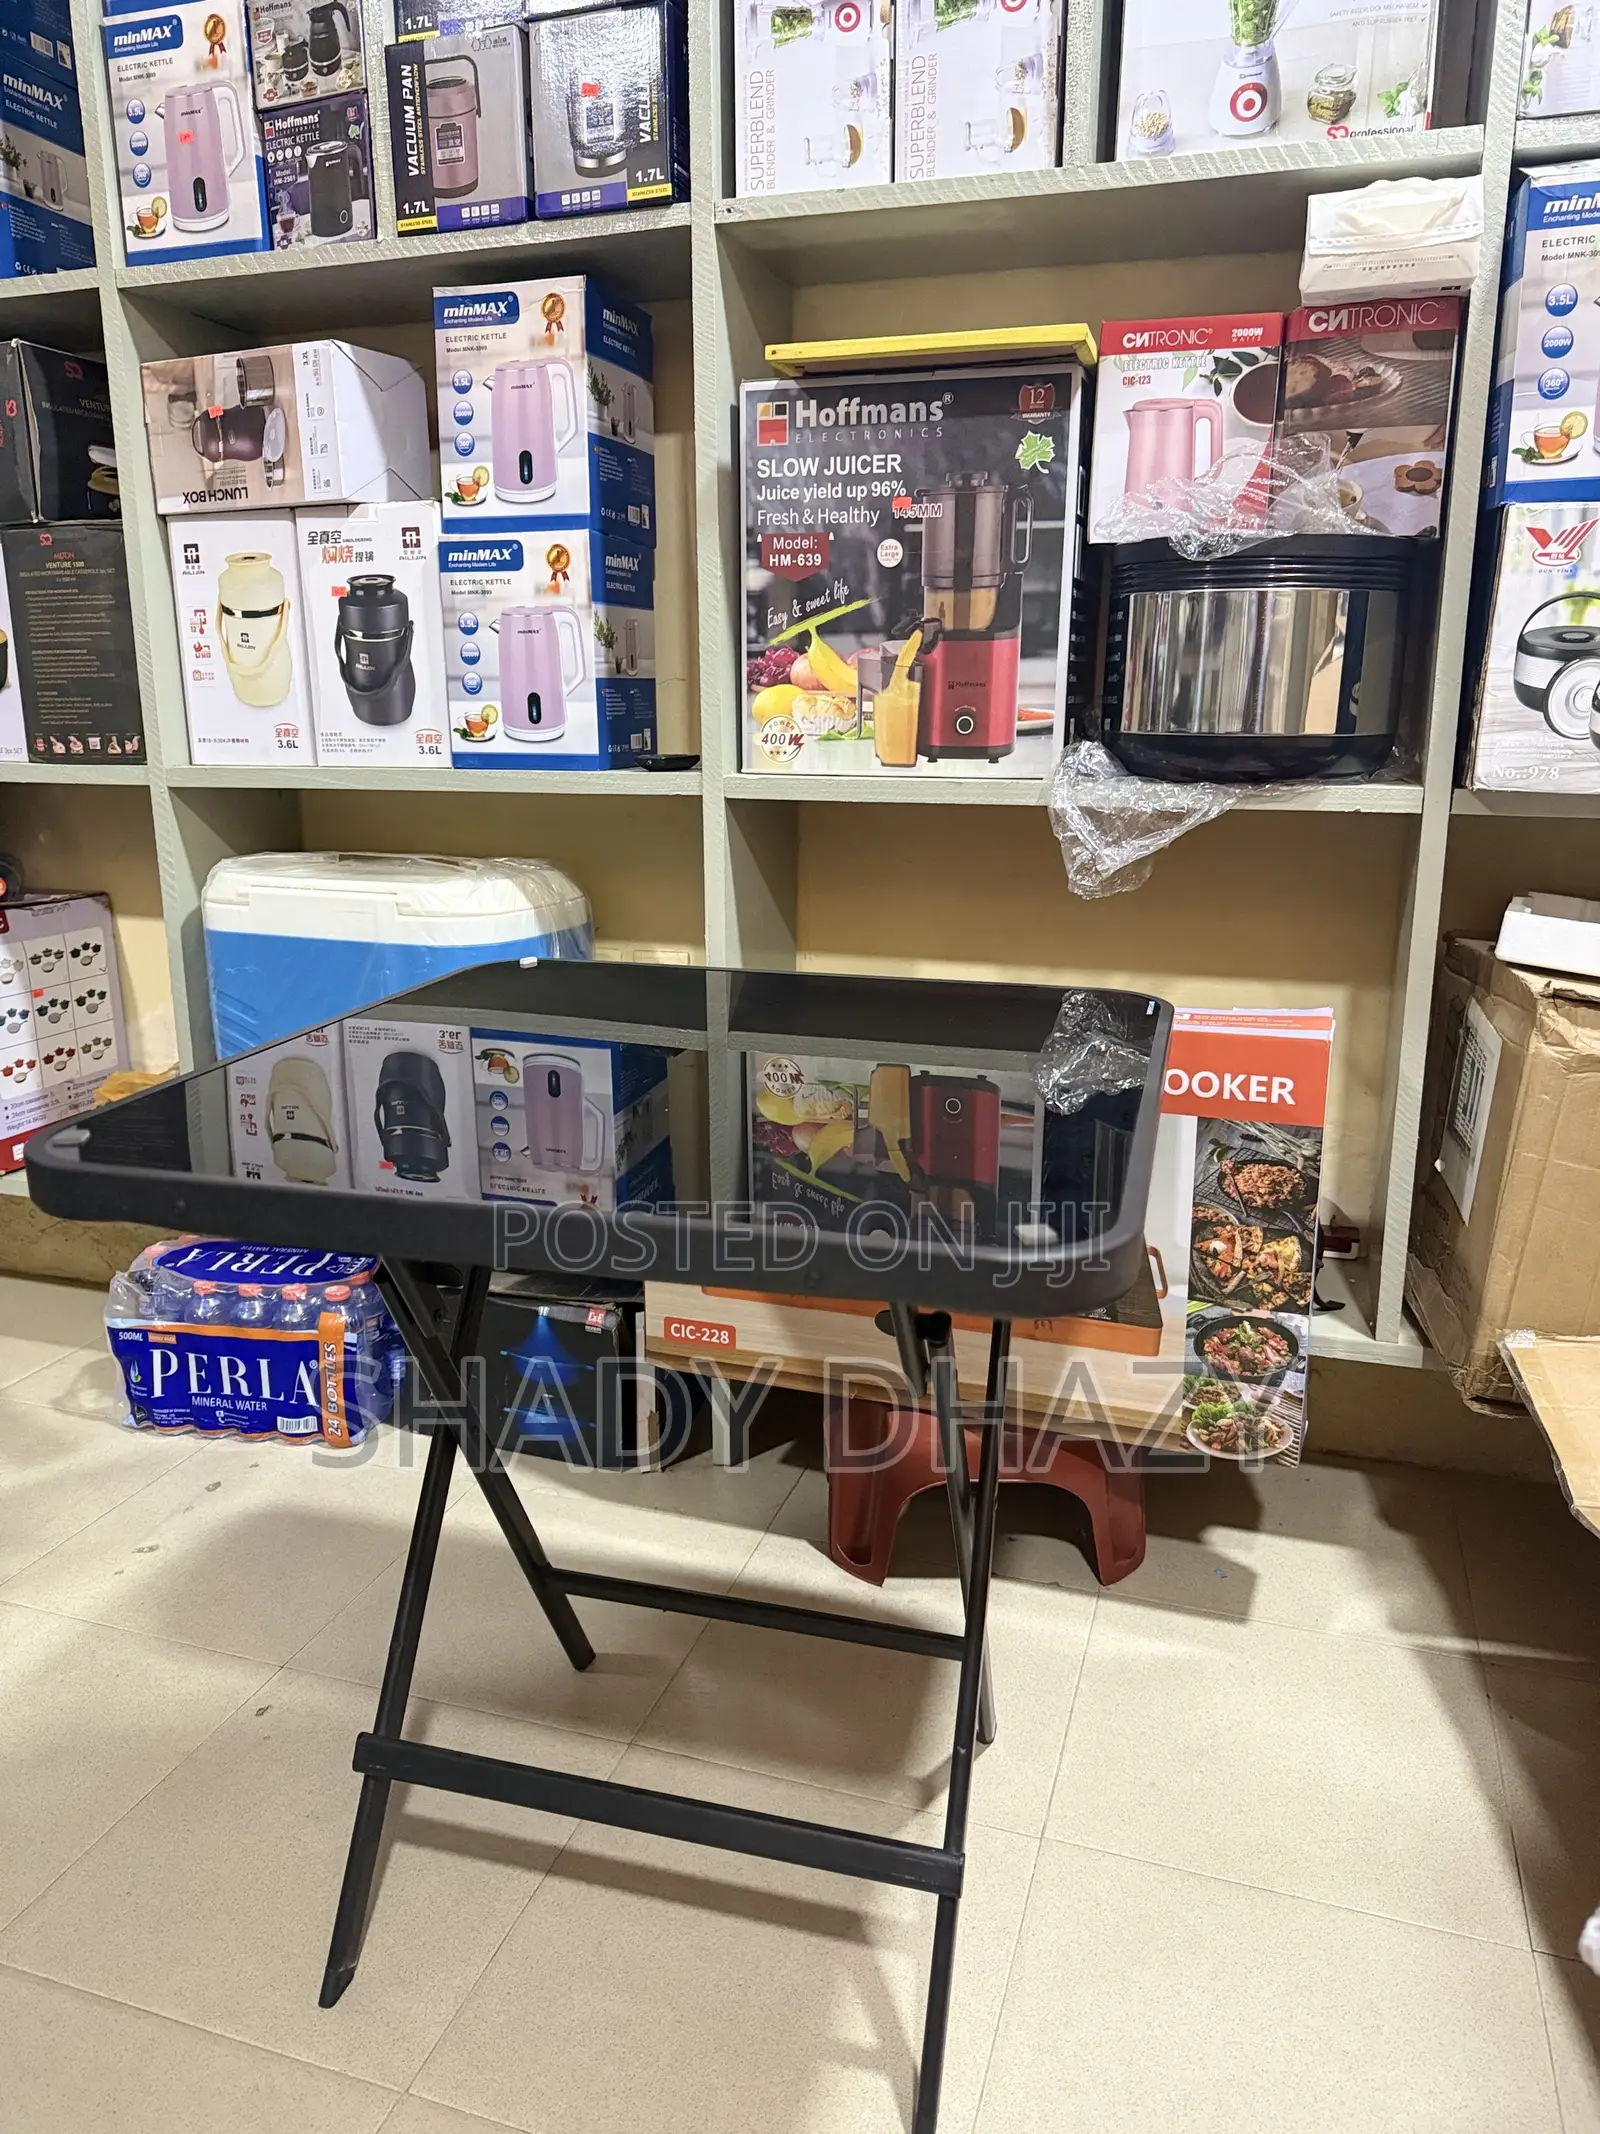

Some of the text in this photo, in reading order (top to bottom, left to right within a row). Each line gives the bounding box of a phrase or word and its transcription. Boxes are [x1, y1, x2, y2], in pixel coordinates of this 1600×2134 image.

[405, 15, 432, 30] 1.7L
[114, 24, 172, 46] minMAX
[117, 57, 173, 72] ELECTRIC KETTLE
[3, 73, 63, 111] minMAX
[5, 99, 58, 129] ELECTRIC KETTLE
[275, 113, 319, 131] Hoffmans
[401, 65, 419, 176] VACUUM PAN
[909, 55, 926, 180] SUPERBLEND
[926, 53, 938, 178] BLENDER & GRINDER
[750, 70, 765, 191] SUPERBLEND
[765, 69, 776, 190] BLENDER & GRINDER
[266, 131, 320, 151] ELECTRIC KETTLE
[635, 167, 665, 183] 1.7L
[402, 201, 430, 215] 1.7L
[1543, 213, 1581, 223] Enchanting
[1541, 235, 1596, 249] ELECTRIC
[1548, 295, 1574, 306] 3.5L
[444, 301, 508, 317] minMAX
[602, 308, 639, 337] minMAX
[445, 332, 507, 343] ELECTRIC KETTLE
[1231, 327, 1264, 339] 2000W
[1543, 338, 1571, 348] 2000W
[1123, 356, 1207, 371] ELECTRIC KETTLE
[454, 377, 470, 387] 3.5L
[1122, 376, 1152, 386] CIC-123
[1029, 388, 1045, 405] 12
[795, 397, 944, 428] Hoffmans
[796, 427, 943, 443] ELECTRONICS
[757, 454, 902, 479] SLOW JUICER
[183, 486, 248, 504] LUNCH BOX
[757, 480, 906, 504] Juice yield up 96%
[757, 506, 880, 527] Fresh & Healthy
[773, 537, 818, 549] Model:
[448, 549, 512, 561] minMAX
[605, 554, 639, 572] minMAX
[769, 553, 822, 566] HM-639
[880, 551, 900, 559] Large
[767, 578, 850, 629] Easy & sweet life
[460, 619, 477, 628] 3.5L
[769, 720, 795, 731] POWER
[277, 739, 298, 749] 3.6L
[418, 746, 442, 755] 3.6L
[176, 1249, 335, 1276] PERLA
[119, 1332, 143, 1341] 500ML
[671, 1323, 729, 1344] CIC-228
[149, 1348, 320, 1408] PERLA
[326, 1342, 341, 1437] 24 BOTTLES
[191, 1396, 267, 1411] MINERAL WATER
